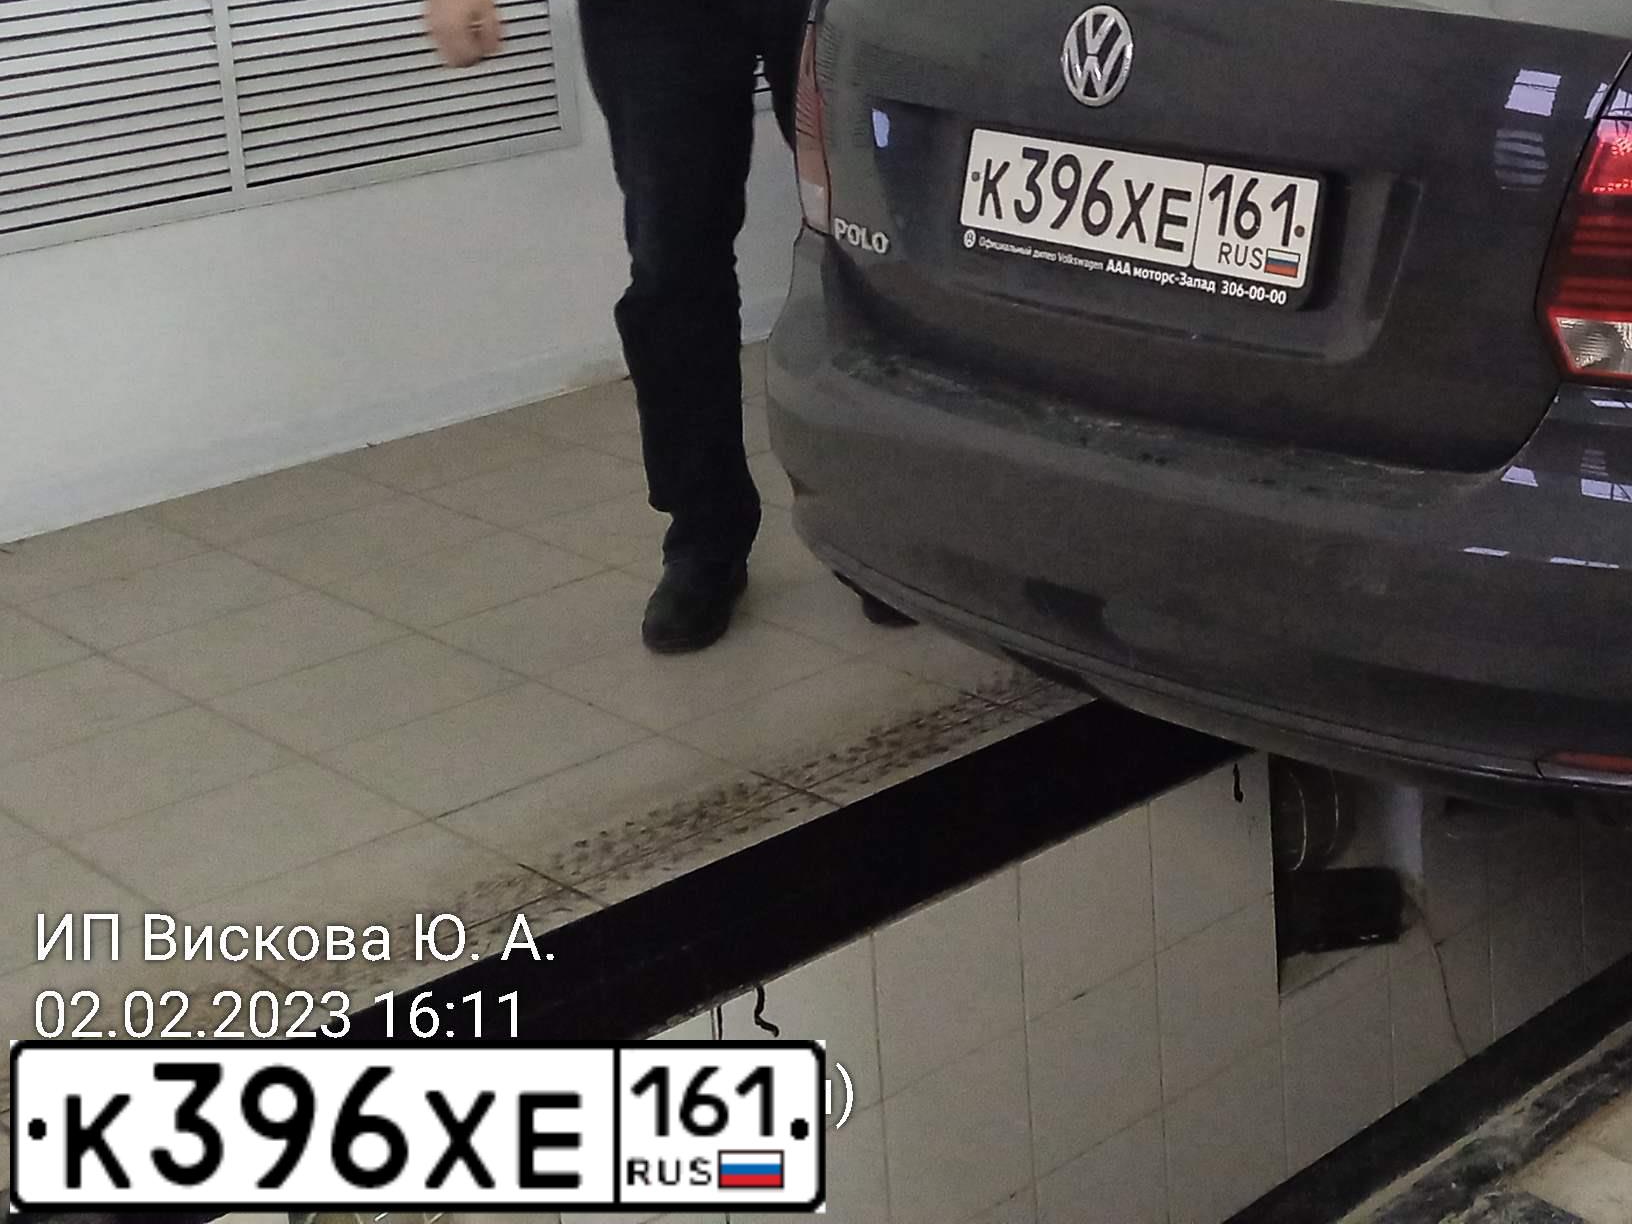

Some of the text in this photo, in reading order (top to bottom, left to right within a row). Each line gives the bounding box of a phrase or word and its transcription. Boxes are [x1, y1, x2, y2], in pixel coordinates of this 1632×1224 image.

[977, 146, 1299, 253] К396ХЕ 161
[833, 216, 890, 255] POLO
[1217, 241, 1264, 271] RUS
[1220, 279, 1287, 305] 306-00-00
